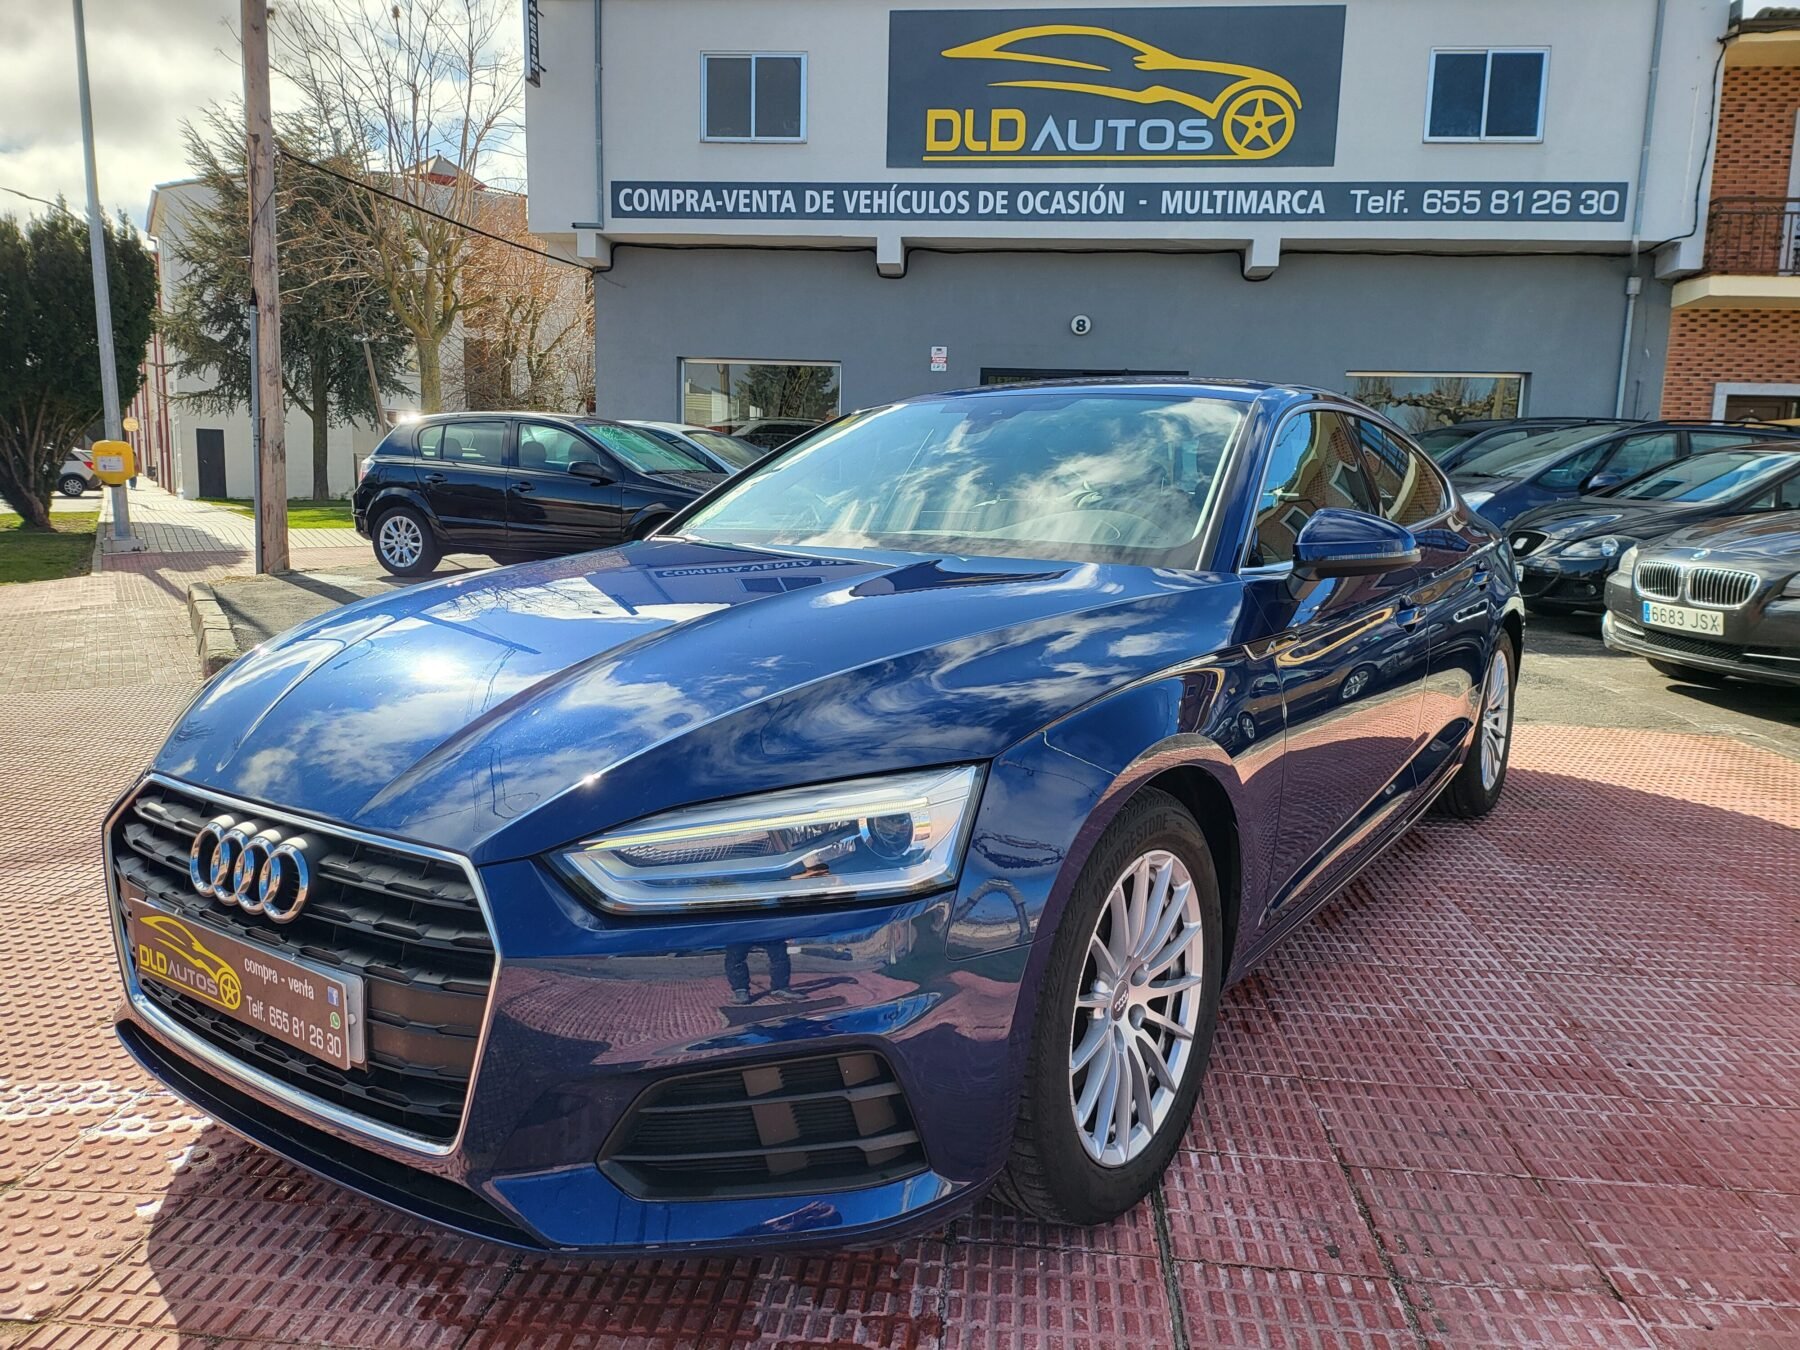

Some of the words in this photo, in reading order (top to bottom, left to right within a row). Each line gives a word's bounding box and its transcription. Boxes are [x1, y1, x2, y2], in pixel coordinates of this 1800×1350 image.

[926, 109, 1026, 152] DLD
[1031, 117, 1213, 152] AUTOS
[618, 188, 797, 213] COMPRA-VENTA
[804, 190, 834, 213] DE
[842, 184, 970, 214] VEHÍCULOS
[977, 190, 1009, 214] DE
[1016, 184, 1125, 215] OCASIÓN
[1161, 190, 1326, 215] MULTIMARCA
[1349, 189, 1409, 214] Telf.
[1422, 190, 1481, 214] 655
[1579, 190, 1620, 215] 30
[1075, 319, 1087, 333] 8
[1652, 606, 1685, 626] 6683
[1690, 613, 1719, 632] JSX
[139, 944, 167, 975] DLD
[168, 960, 218, 995] AUTOS
[244, 957, 279, 985] compra
[287, 975, 315, 1001] venta
[245, 994, 266, 1023] Telf.
[269, 1005, 290, 1033] 655
[292, 1016, 306, 1041] 81
[309, 1024, 324, 1050] 26
[326, 1032, 342, 1059] 30
